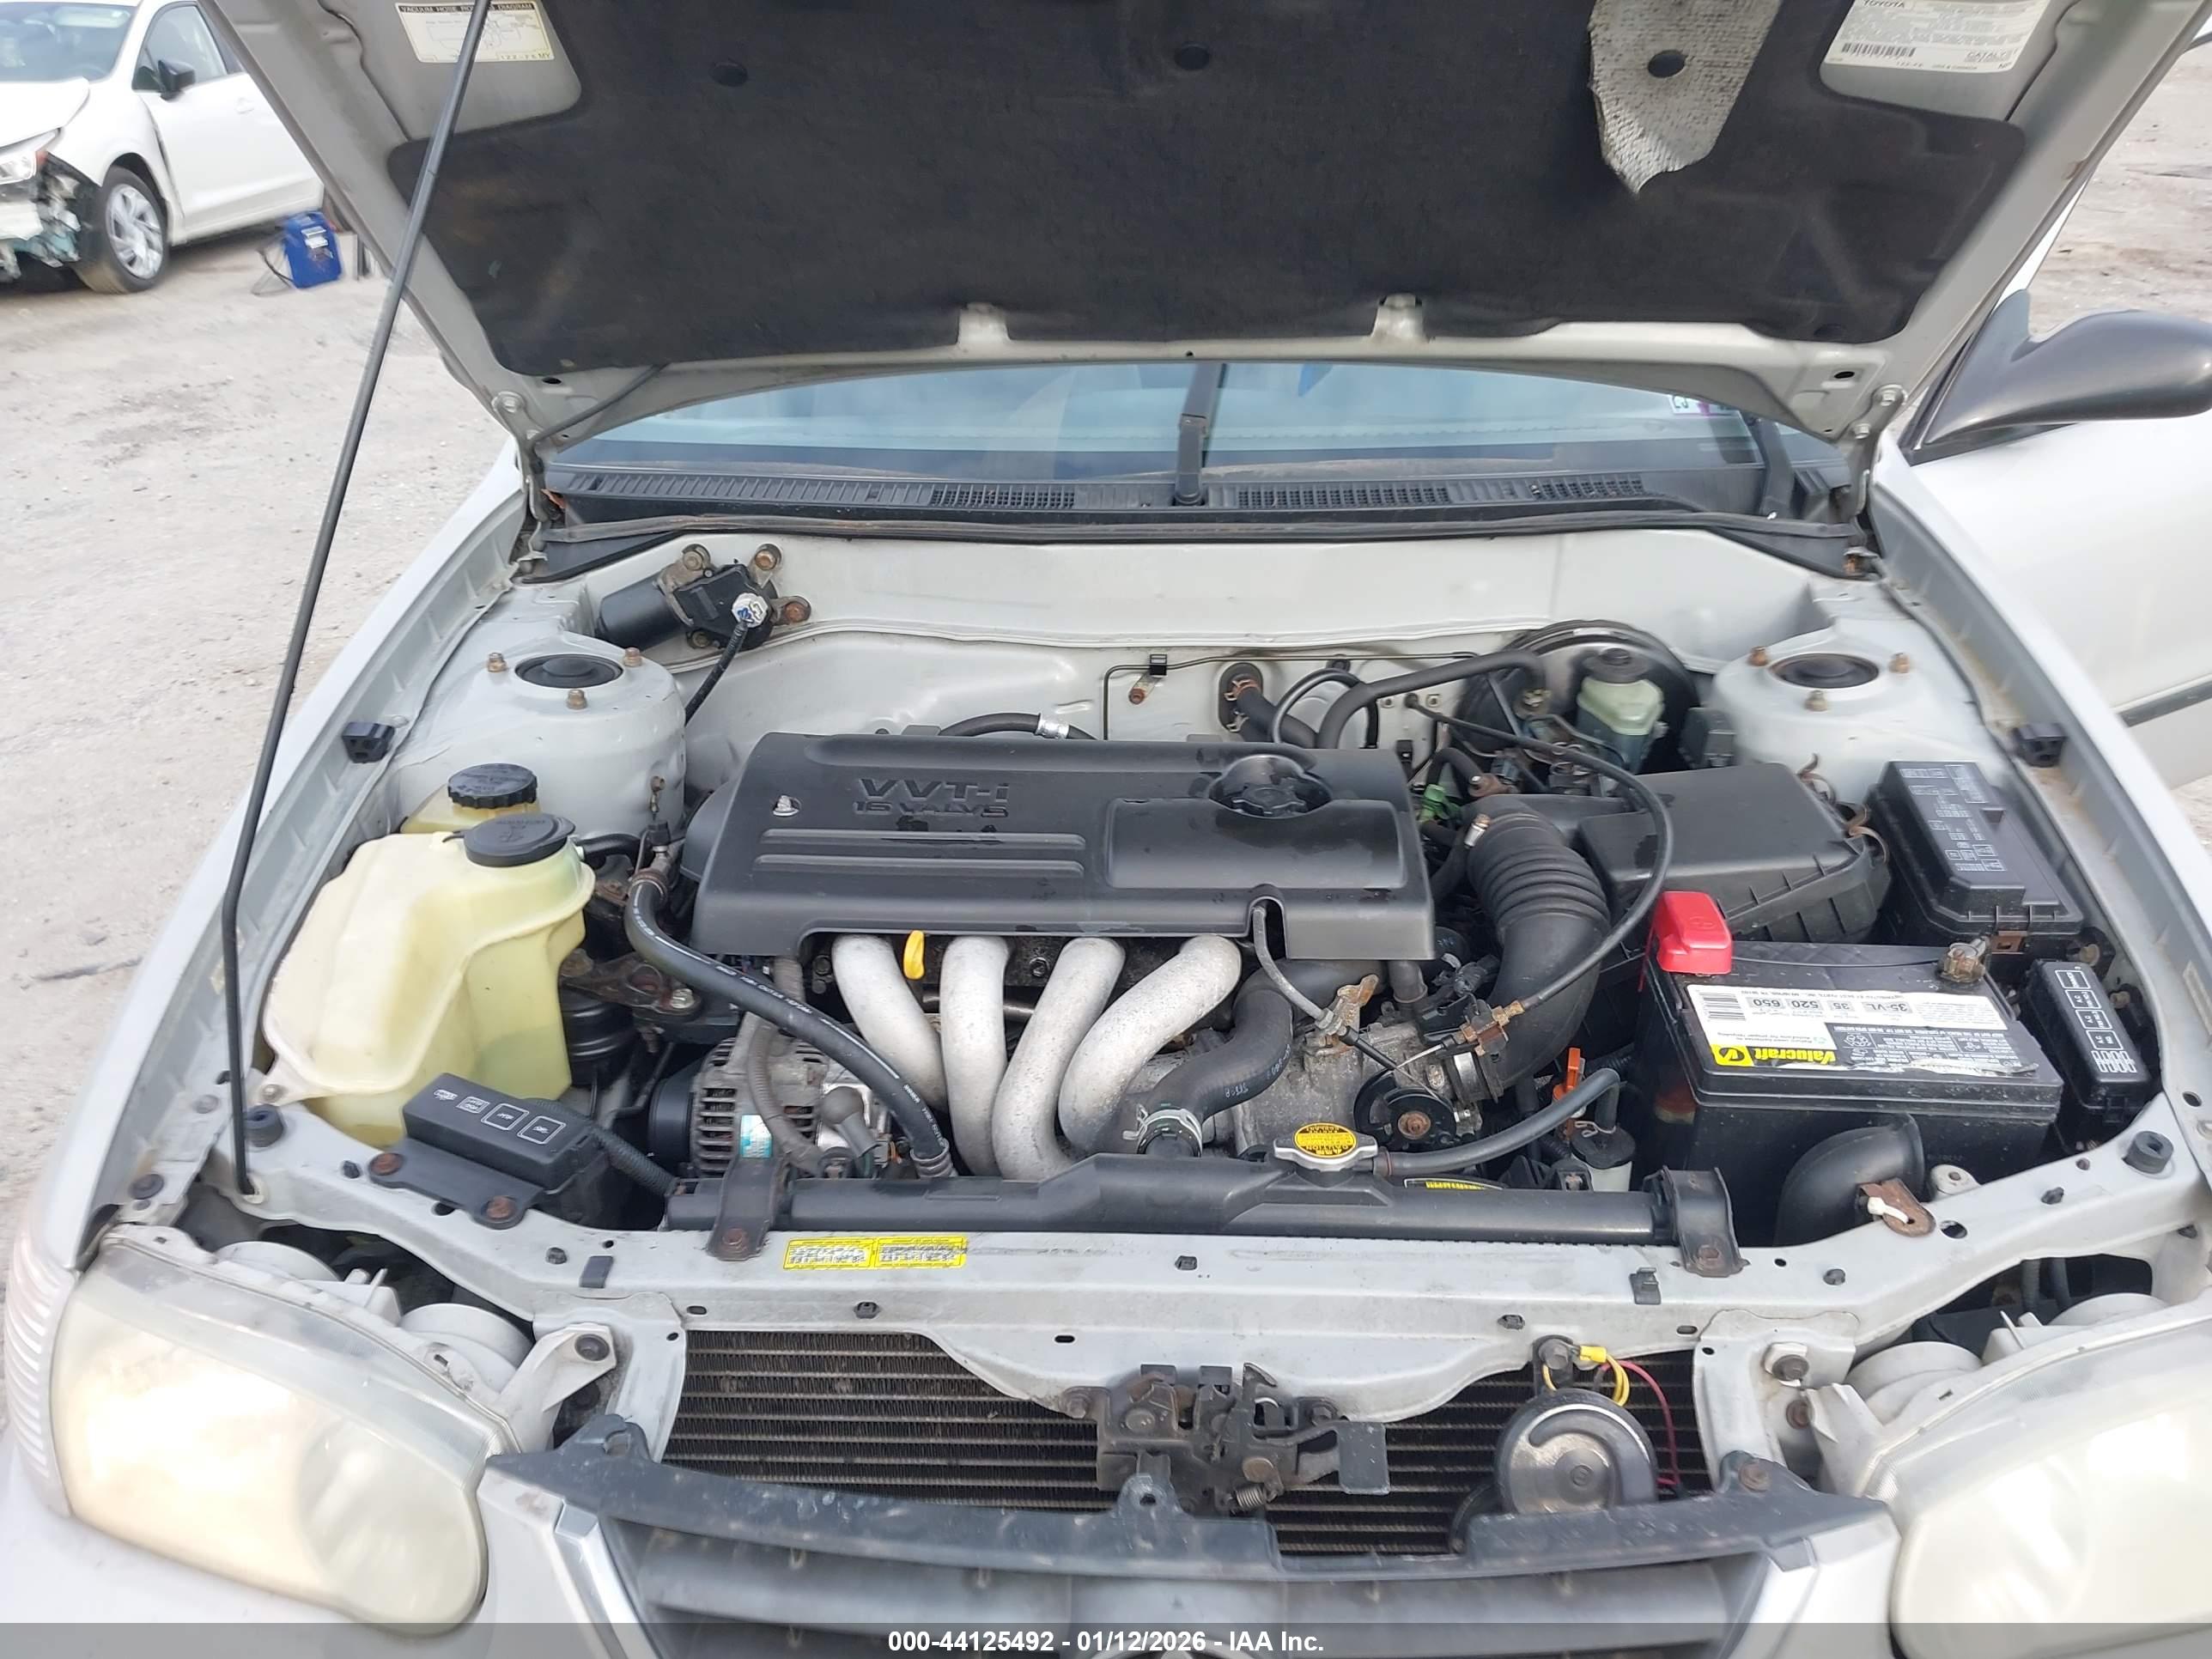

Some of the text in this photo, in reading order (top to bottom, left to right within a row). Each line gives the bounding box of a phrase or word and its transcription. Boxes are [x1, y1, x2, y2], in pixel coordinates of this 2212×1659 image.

[853, 799, 893, 815] 16
[1753, 999, 1781, 1007] 650
[1791, 1000, 1819, 1009] 520
[1754, 1048, 1836, 1065] Valucraft
